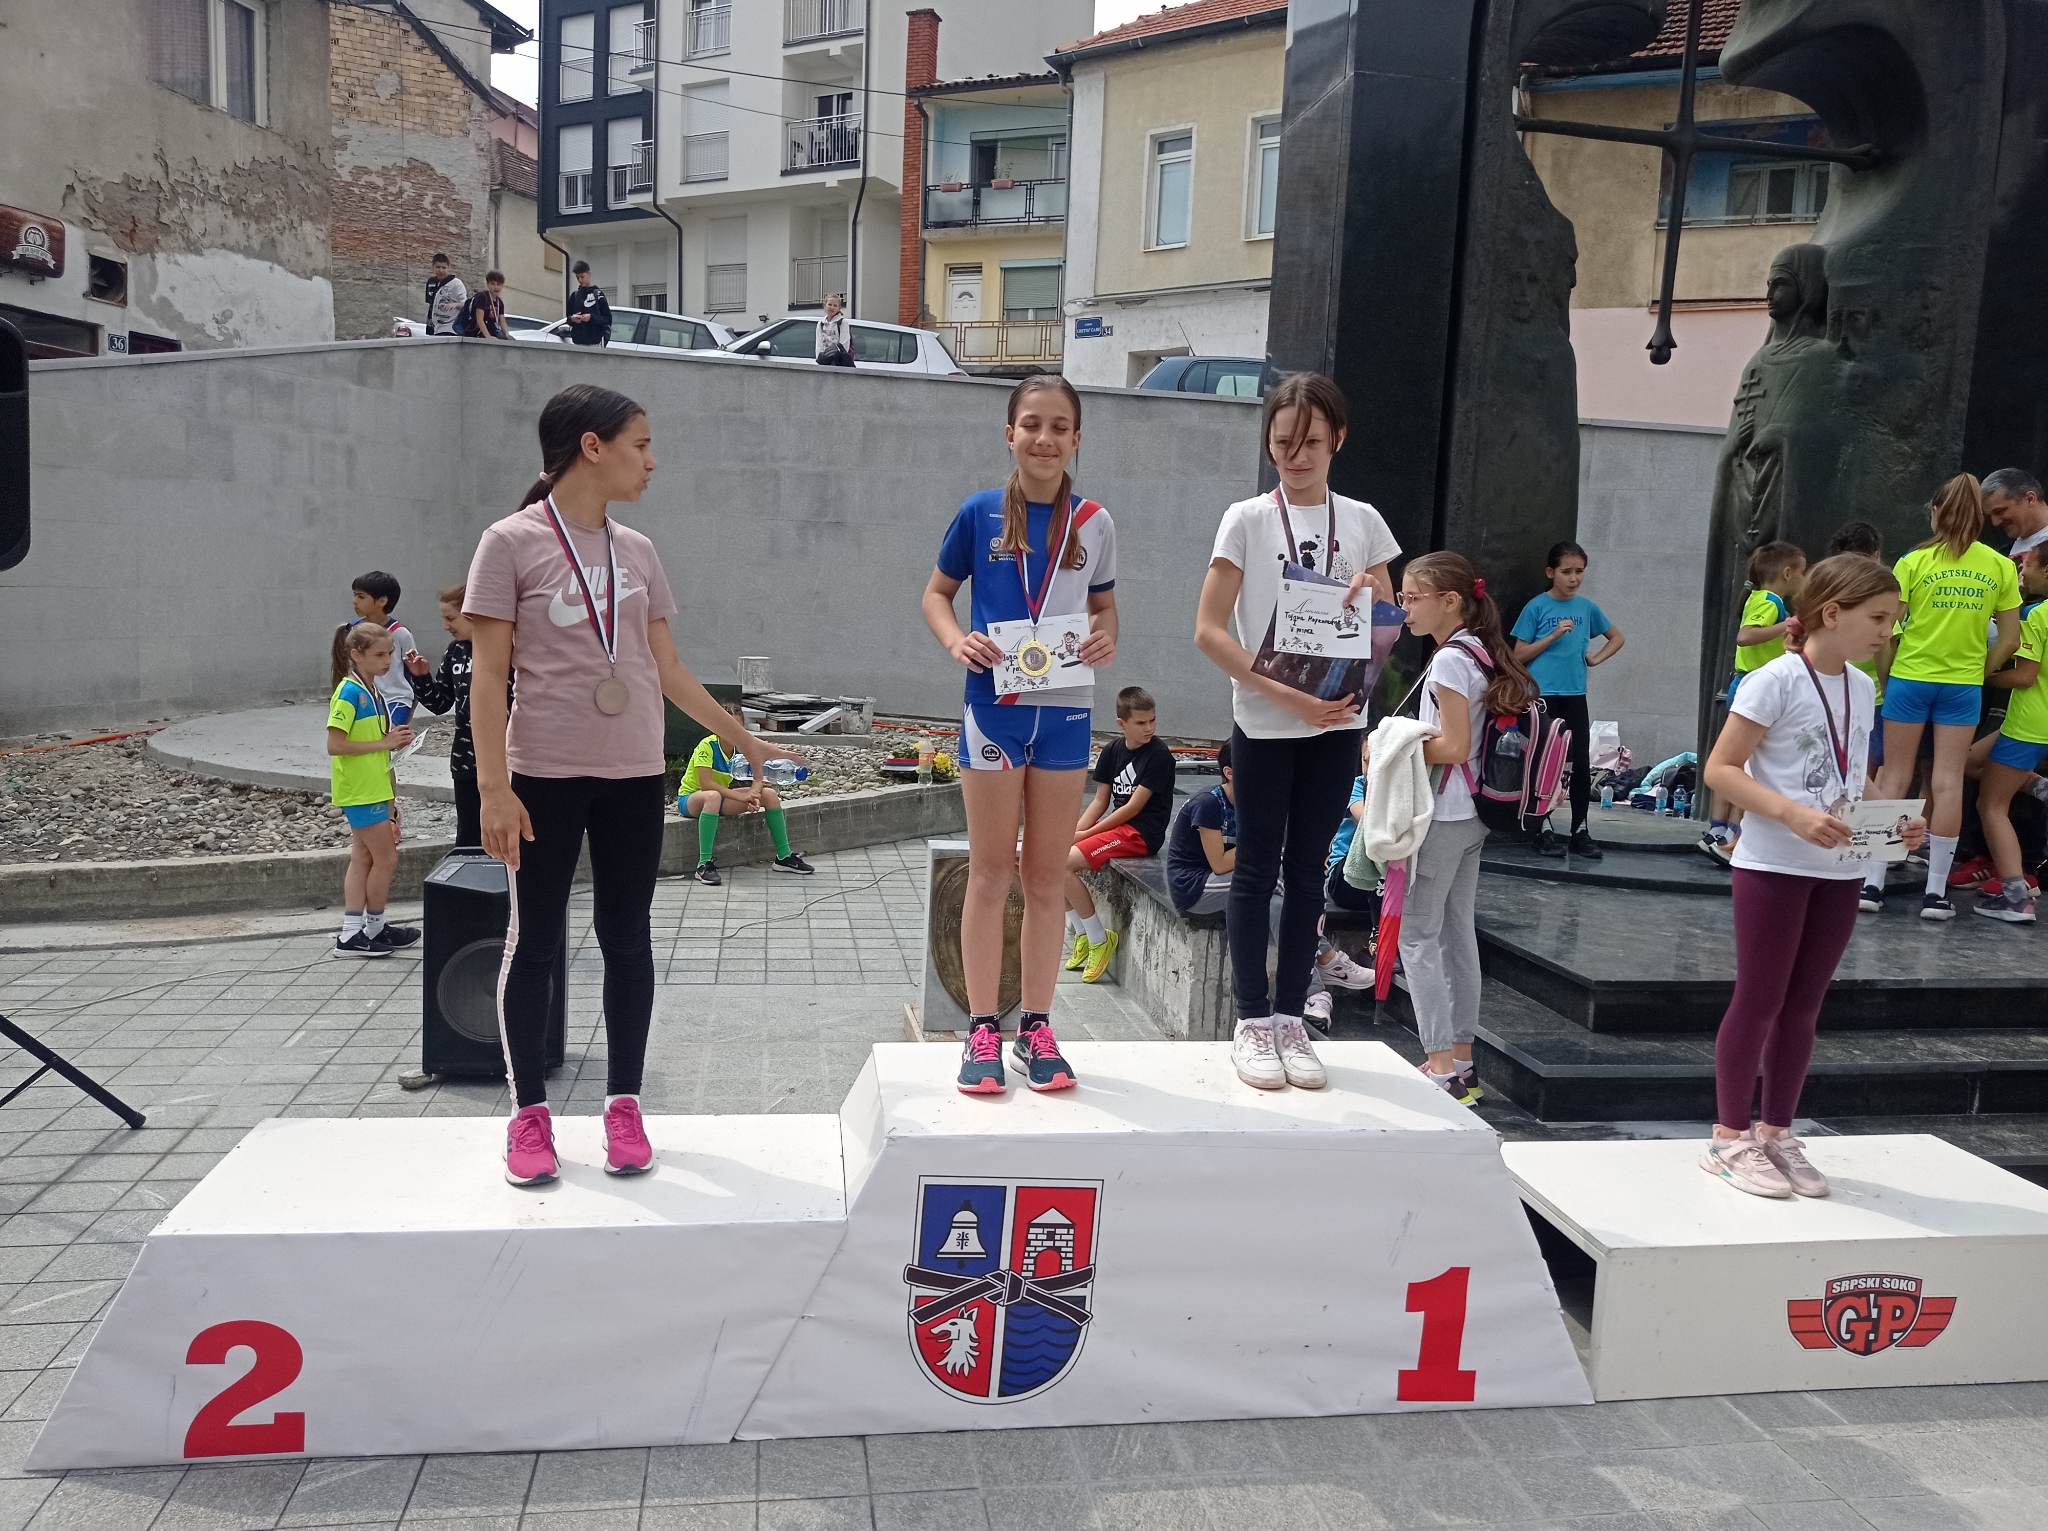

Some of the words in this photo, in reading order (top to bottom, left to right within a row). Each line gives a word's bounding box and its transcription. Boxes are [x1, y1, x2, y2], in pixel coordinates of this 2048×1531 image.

[111, 337, 124, 350] 36
[1923, 569, 1973, 587] ATLETSKI
[1974, 570, 1998, 591] KLUB
[1935, 586, 1985, 598] JUNIOR
[1932, 601, 1984, 611] KRUPANJ
[1831, 1277, 1880, 1294] SRPSKI
[1881, 1277, 1917, 1292] SOKO
[1397, 1266, 1477, 1402] 1
[183, 1319, 305, 1459] 2
